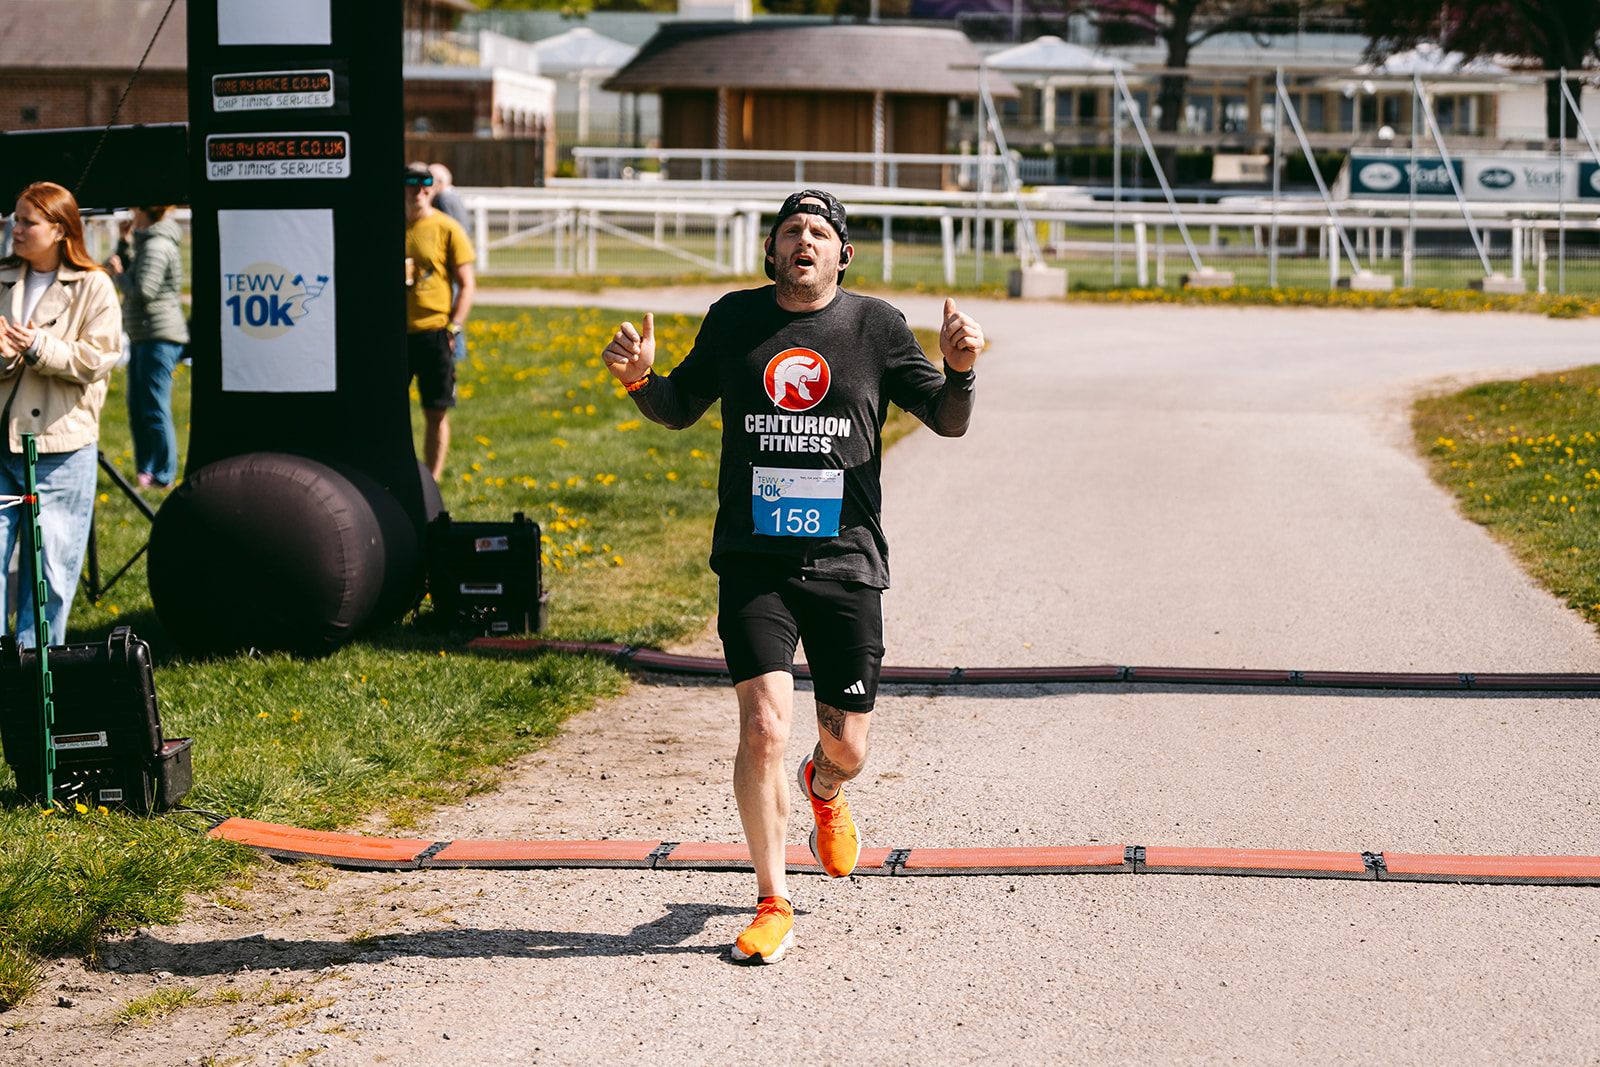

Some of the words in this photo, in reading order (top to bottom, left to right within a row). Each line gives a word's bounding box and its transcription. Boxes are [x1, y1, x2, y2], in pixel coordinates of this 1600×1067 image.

[218, 99, 238, 109] CHIP
[241, 96, 272, 108] TIMING
[276, 94, 329, 106] SERVICES
[211, 164, 233, 177] CHIP
[238, 163, 276, 176] TIMING
[280, 161, 343, 175] SERVICES
[224, 274, 284, 292] TEWV
[225, 294, 295, 327] 10k
[744, 414, 852, 438] CENTURION
[759, 435, 832, 454] FITNESS
[758, 476, 779, 484] TEWV
[758, 484, 781, 497] 10k
[770, 508, 821, 534] 158
